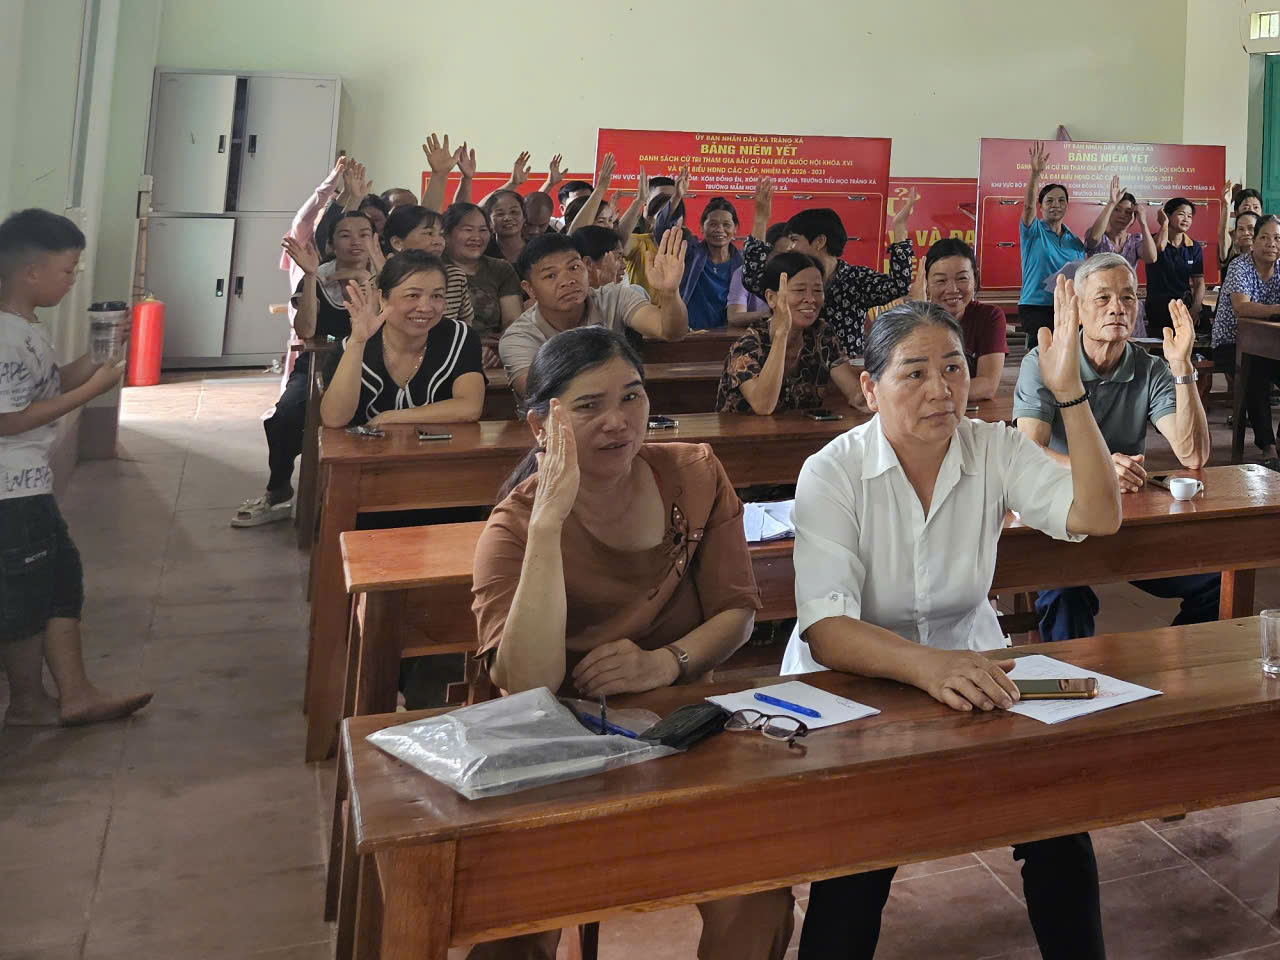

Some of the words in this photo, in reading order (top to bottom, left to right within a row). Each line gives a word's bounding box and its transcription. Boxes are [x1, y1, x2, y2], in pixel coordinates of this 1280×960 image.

[701, 142, 736, 154] BẢNG
[740, 144, 772, 155] NIÊM
[776, 144, 798, 156] YẾT
